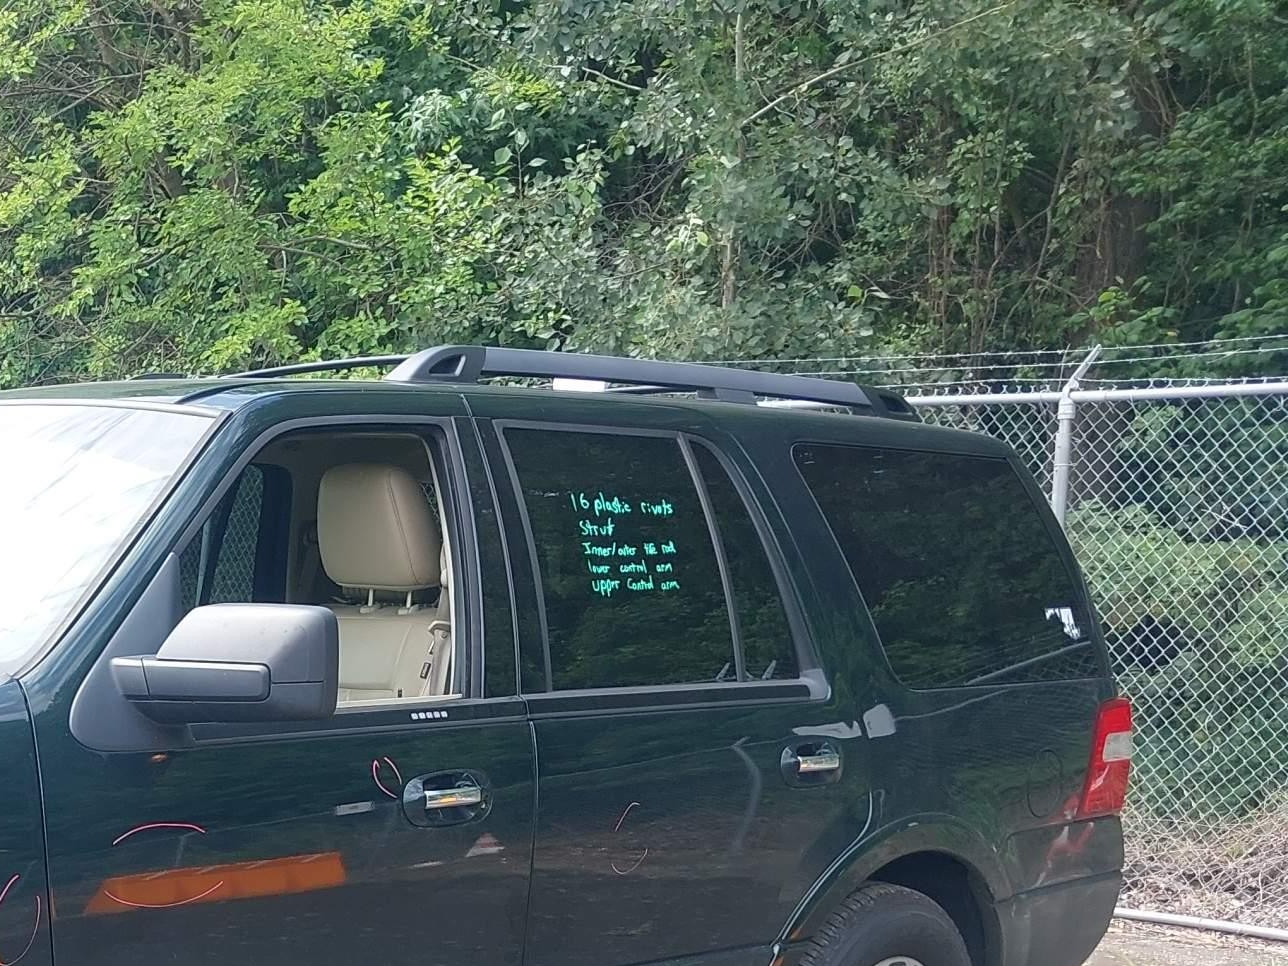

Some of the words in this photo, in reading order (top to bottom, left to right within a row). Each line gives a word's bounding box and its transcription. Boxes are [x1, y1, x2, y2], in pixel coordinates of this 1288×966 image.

[571, 493, 590, 512] 16
[594, 492, 632, 517] plastic
[655, 563, 673, 573] arm
[660, 580, 681, 591] arm
